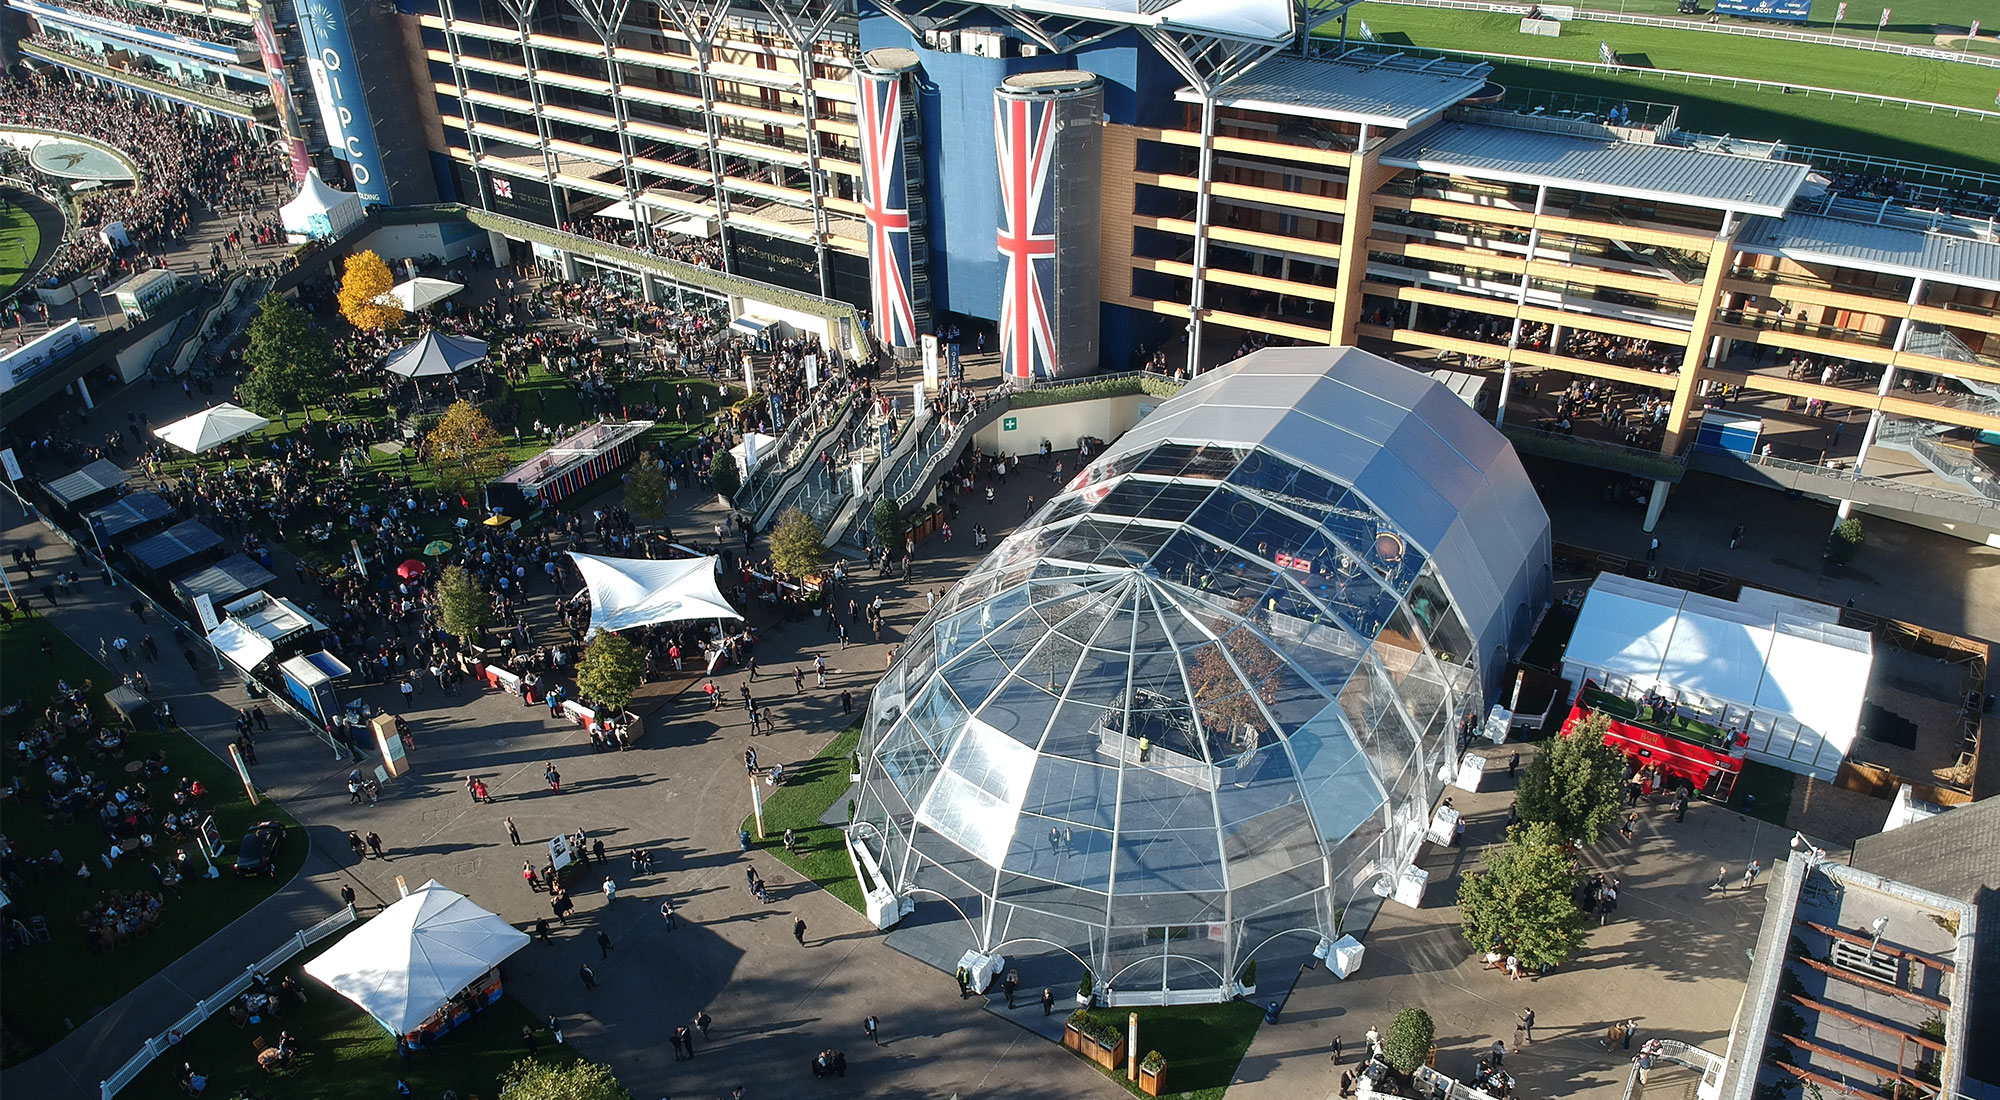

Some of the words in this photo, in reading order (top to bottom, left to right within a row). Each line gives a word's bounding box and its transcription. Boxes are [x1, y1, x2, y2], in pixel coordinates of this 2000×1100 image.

[322, 48, 370, 185] QIPCO
[358, 192, 380, 201] OLDING
[528, 195, 550, 207] ASCOT
[629, 261, 656, 274] KITCHEN
[276, 633, 292, 647] THE
[293, 627, 311, 640] BAR
